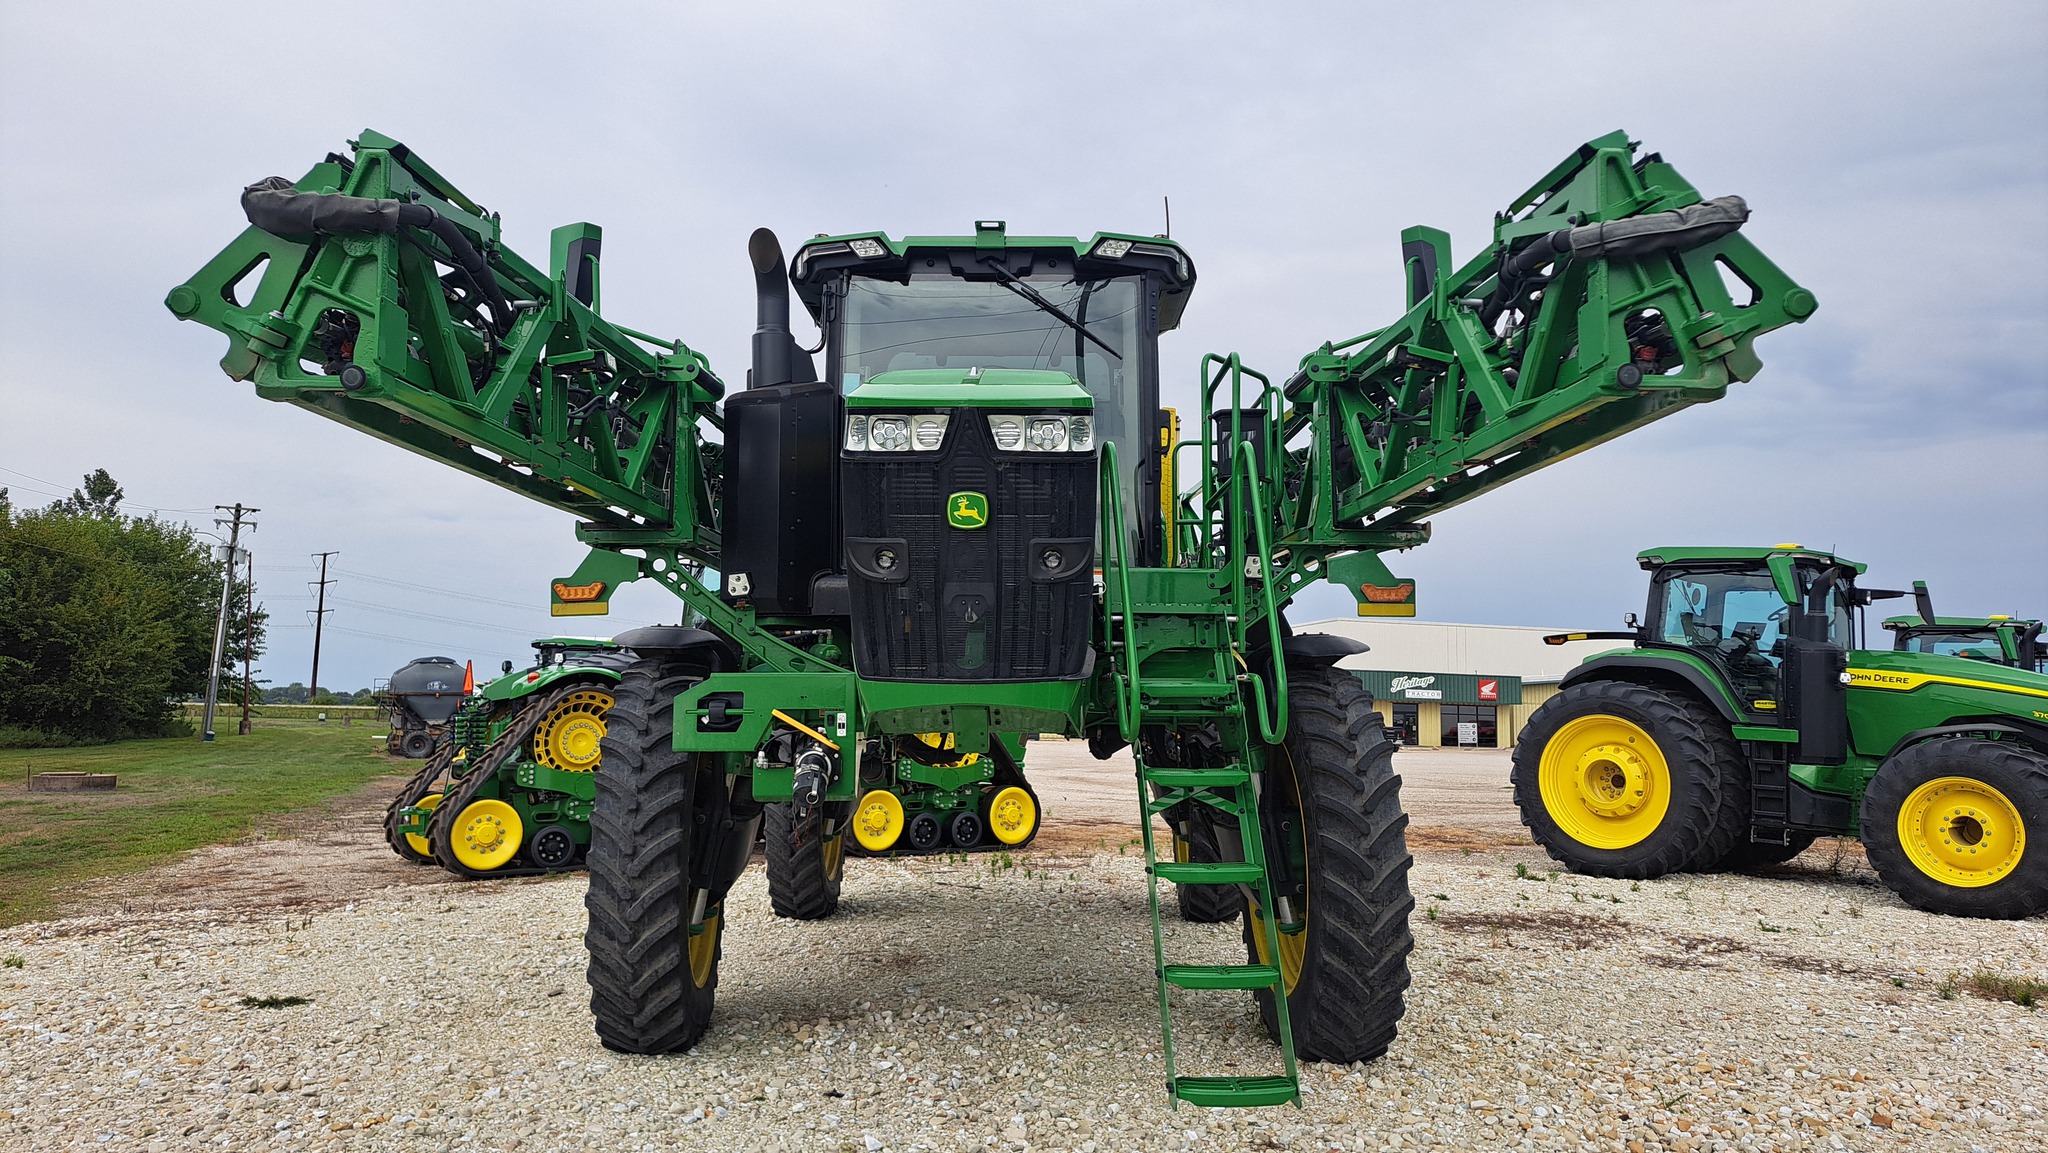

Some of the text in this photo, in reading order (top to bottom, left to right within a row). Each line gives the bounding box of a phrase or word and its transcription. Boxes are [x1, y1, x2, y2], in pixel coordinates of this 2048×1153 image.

[1390, 676, 1435, 692] Heritage
[1850, 673, 1910, 684] OHN DEERE
